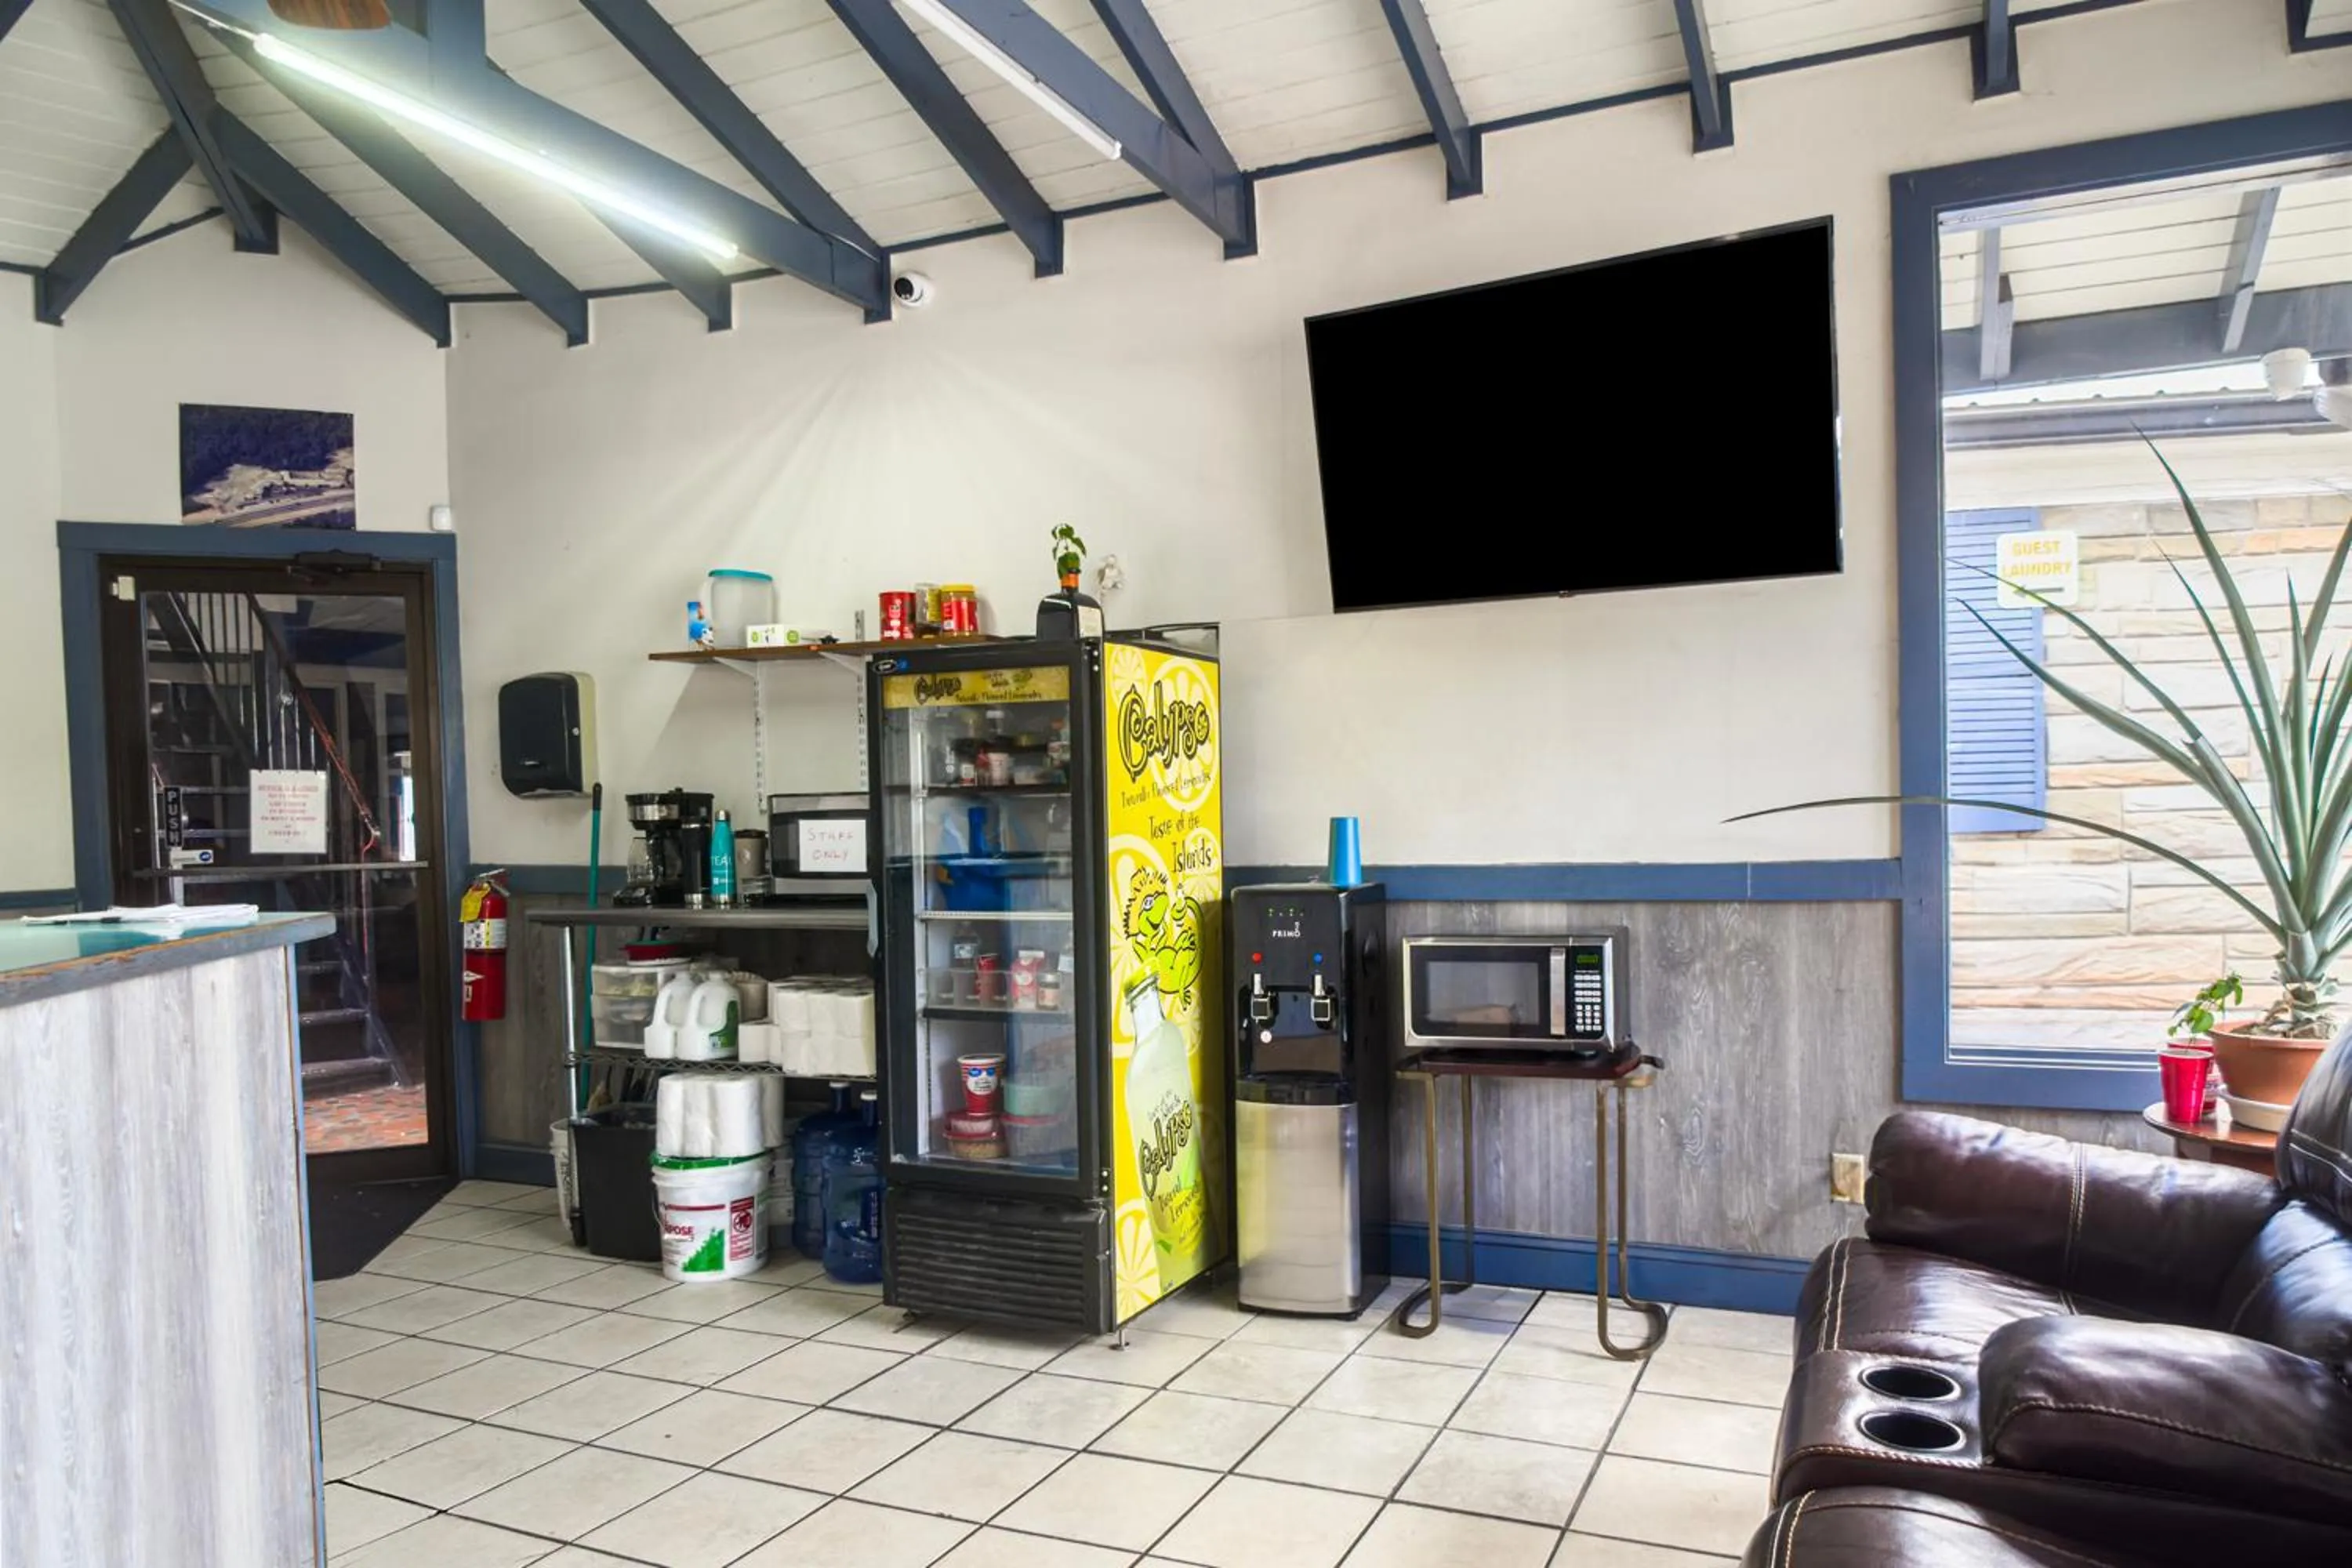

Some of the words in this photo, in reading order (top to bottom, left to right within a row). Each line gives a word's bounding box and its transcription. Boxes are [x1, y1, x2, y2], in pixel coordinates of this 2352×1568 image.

[2012, 540, 2060, 556] GUEST
[2002, 561, 2071, 577] LAUNDRY
[914, 674, 962, 706] Calypso
[1118, 680, 1210, 783] Calypso
[167, 790, 179, 844] PUSH
[1149, 815, 1173, 840] Taste
[1176, 809, 1186, 832] of
[808, 827, 854, 841] STAFF
[812, 848, 848, 861] ONLY
[1171, 837, 1211, 873] Islands
[1272, 929, 1301, 938] PRIMO
[1138, 1099, 1192, 1202] Calypso
